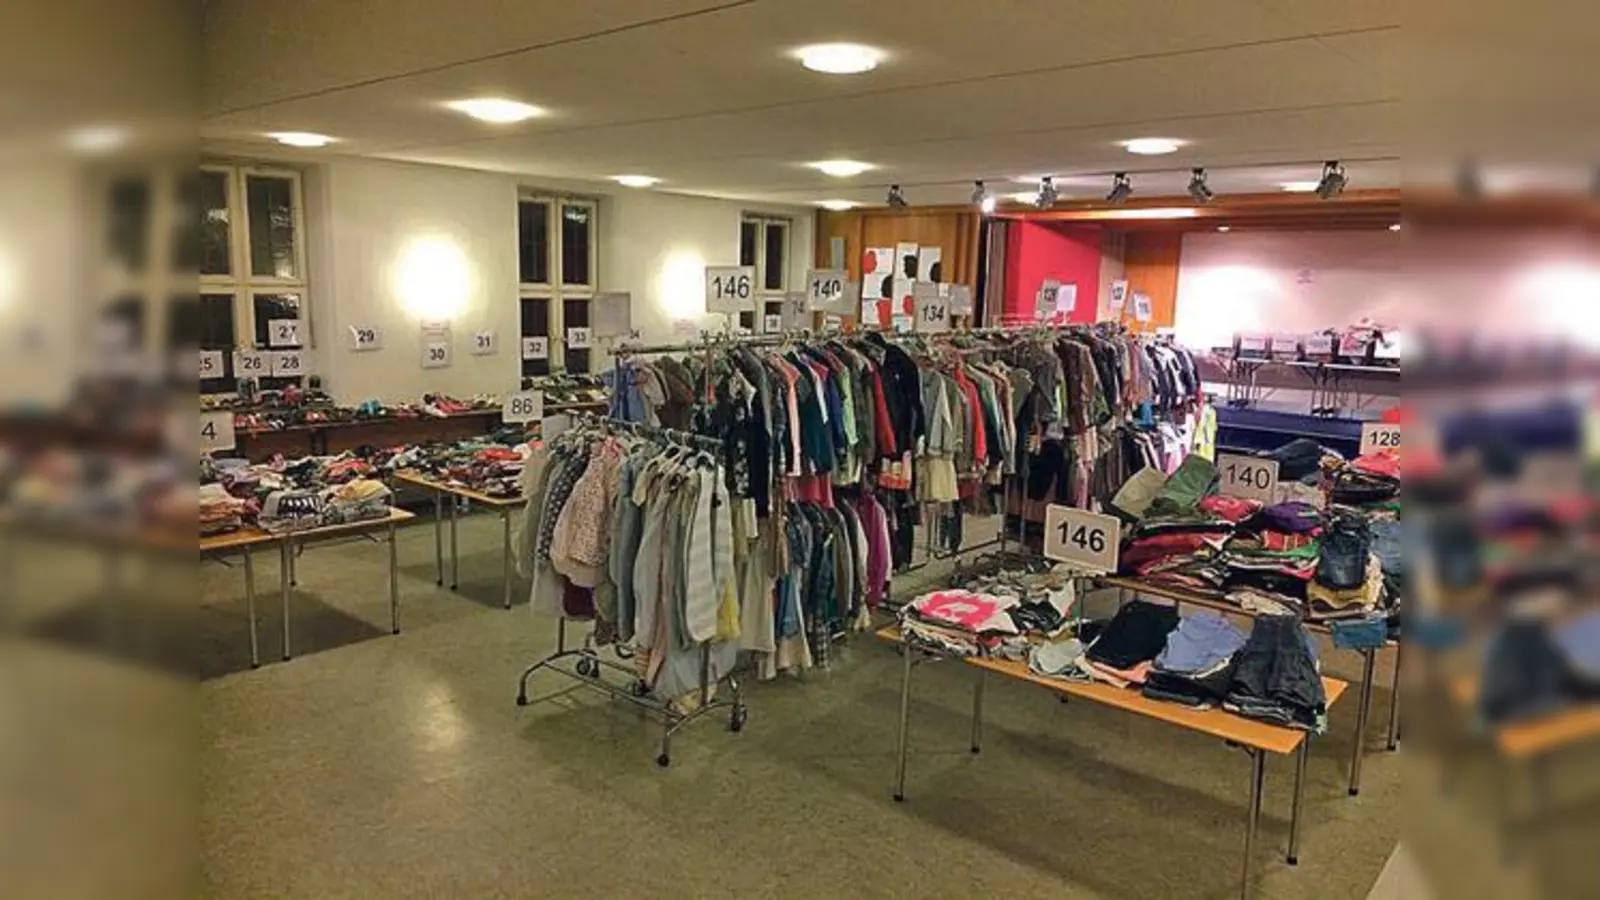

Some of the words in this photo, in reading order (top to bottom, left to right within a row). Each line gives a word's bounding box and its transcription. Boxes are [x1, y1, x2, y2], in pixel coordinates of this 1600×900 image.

[712, 275, 750, 299] 146
[923, 305, 944, 322] 134
[279, 325, 297, 338] 27
[358, 329, 375, 343] 29
[476, 335, 490, 348] 31
[430, 348, 445, 360] 30
[199, 358, 213, 371] 5
[244, 357, 261, 369] 26
[281, 357, 299, 369] 28
[511, 398, 533, 414] 86
[1369, 431, 1400, 447] 128
[1227, 463, 1270, 490] 140
[1057, 521, 1105, 552] 146
